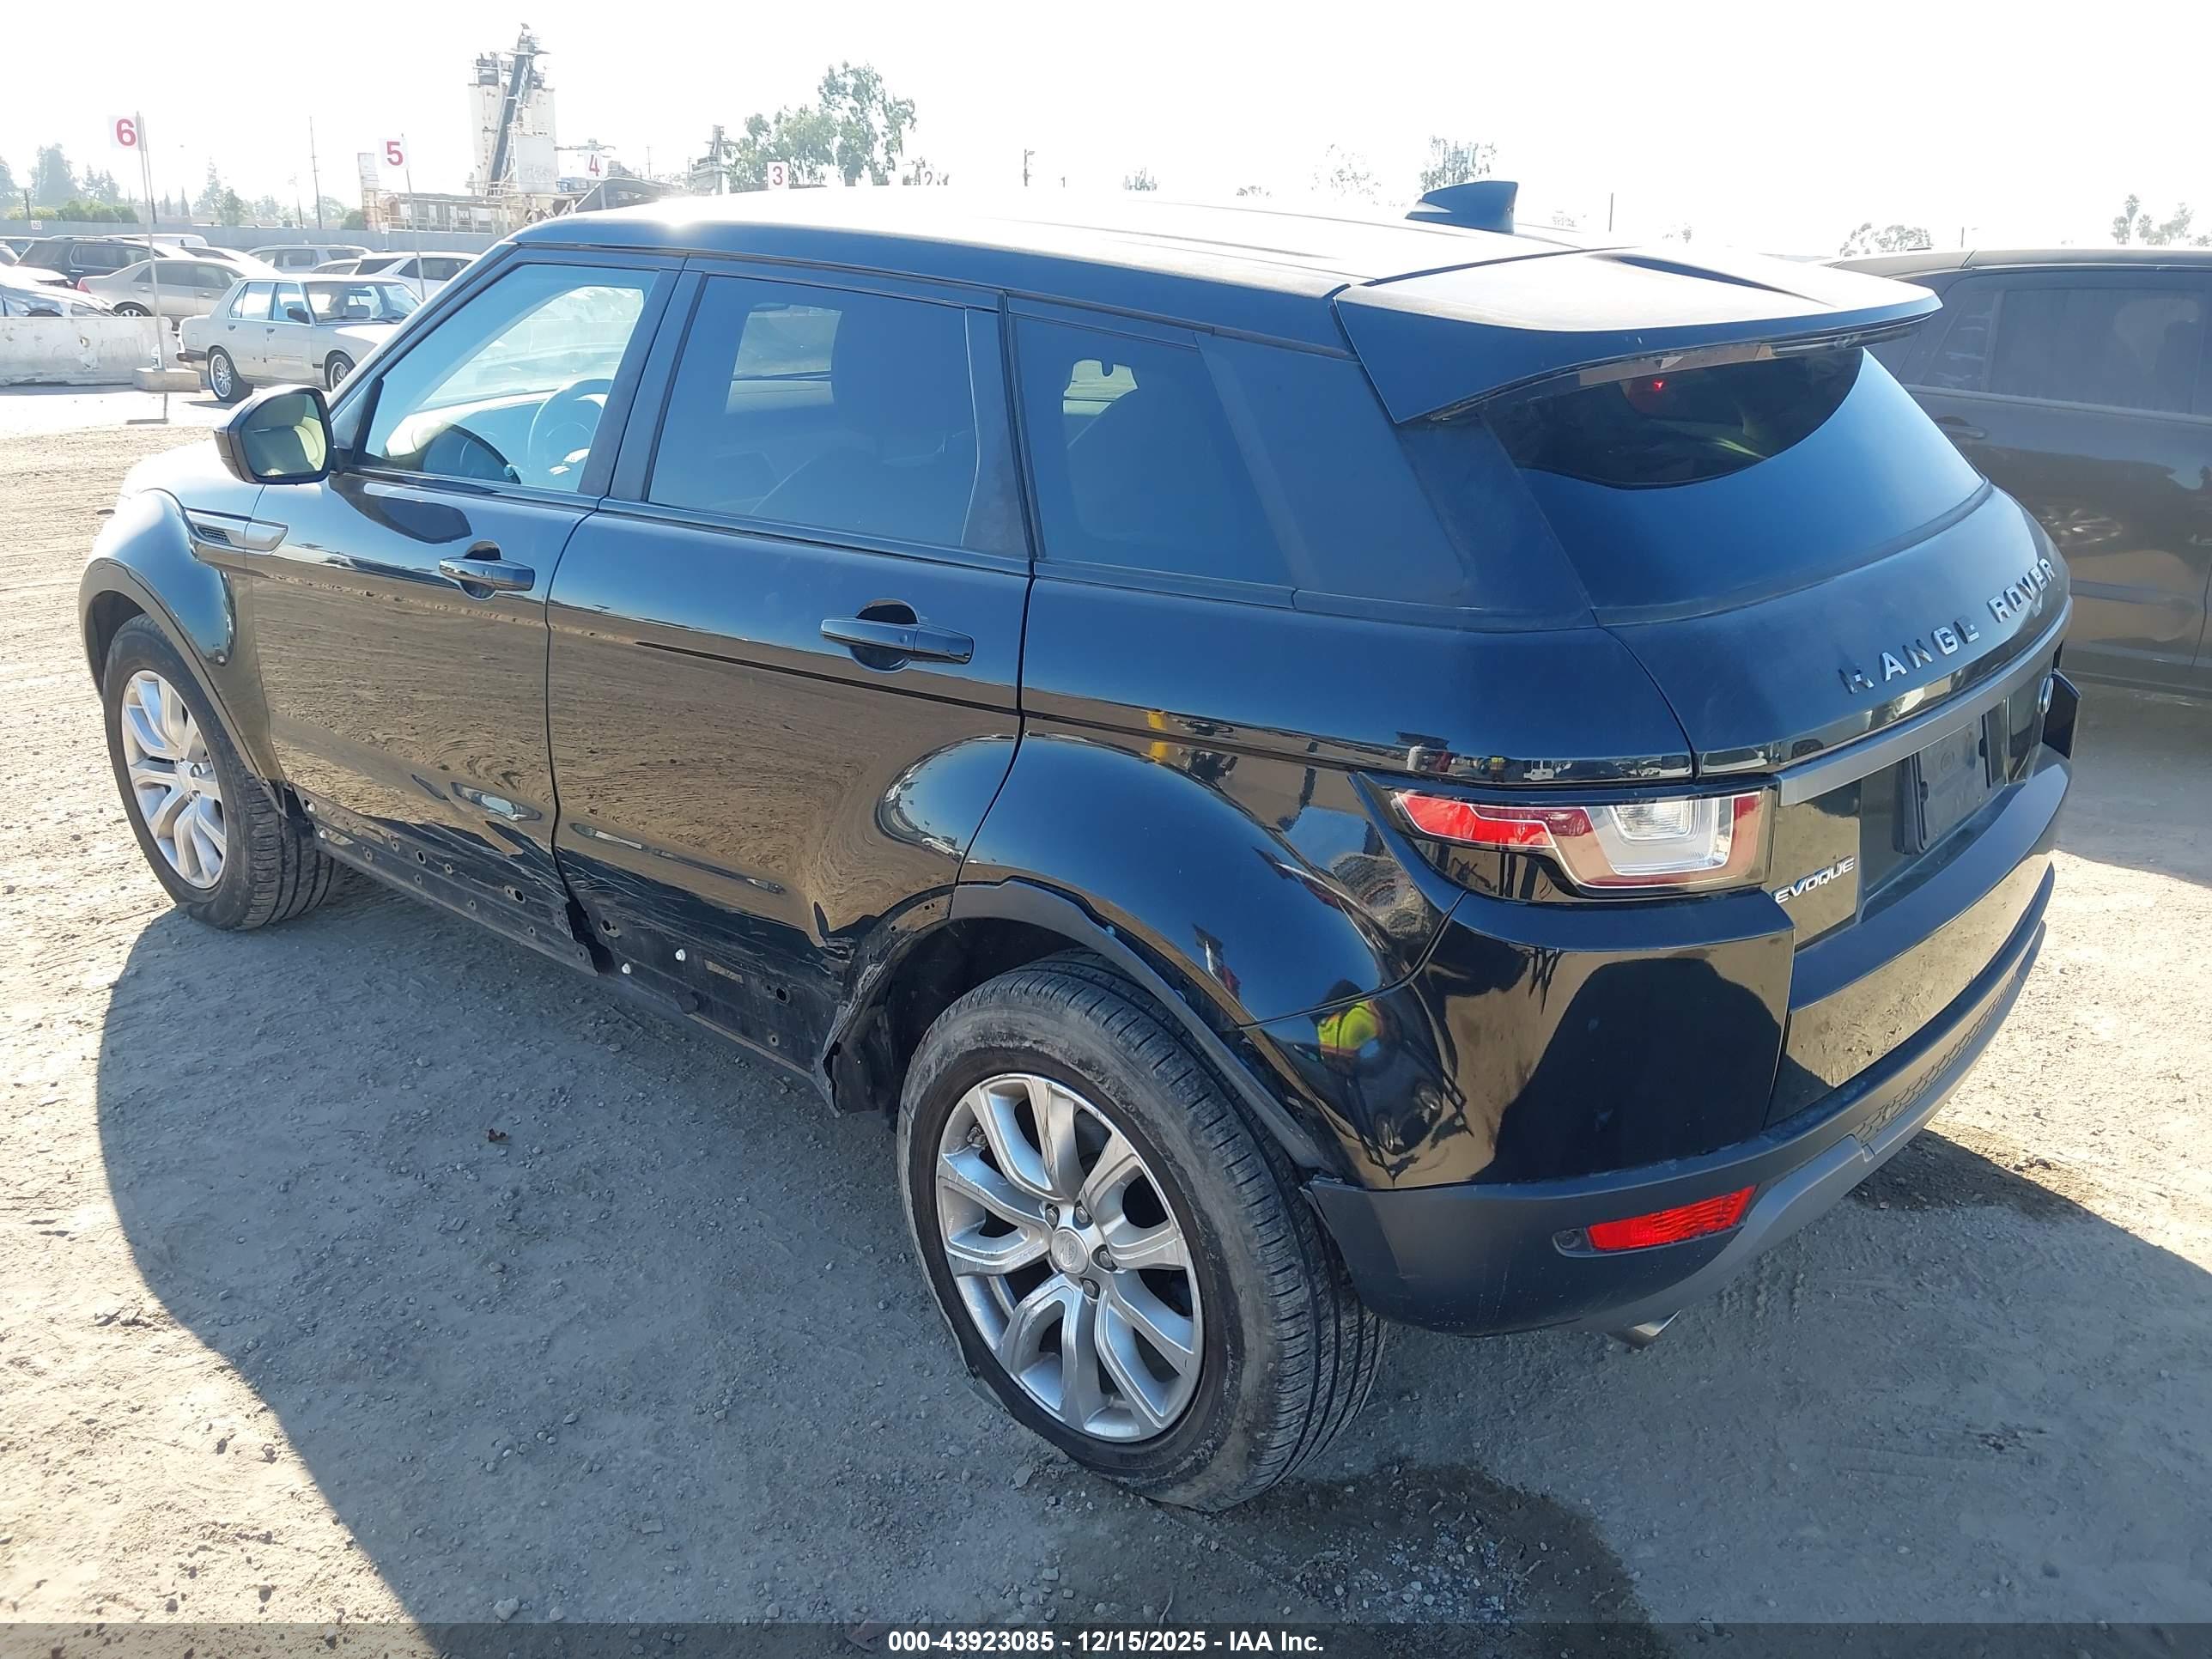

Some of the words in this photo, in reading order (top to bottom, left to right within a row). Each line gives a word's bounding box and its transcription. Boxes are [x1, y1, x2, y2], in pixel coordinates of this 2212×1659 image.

[117, 118, 136, 146] 6
[386, 141, 404, 166] 5
[589, 154, 600, 176] 4
[772, 166, 783, 186] 3
[924, 171, 933, 185] 2
[1838, 616, 1980, 695] RANGE
[1986, 557, 2057, 623] ROVER
[1772, 855, 1855, 904] EVOQUE
